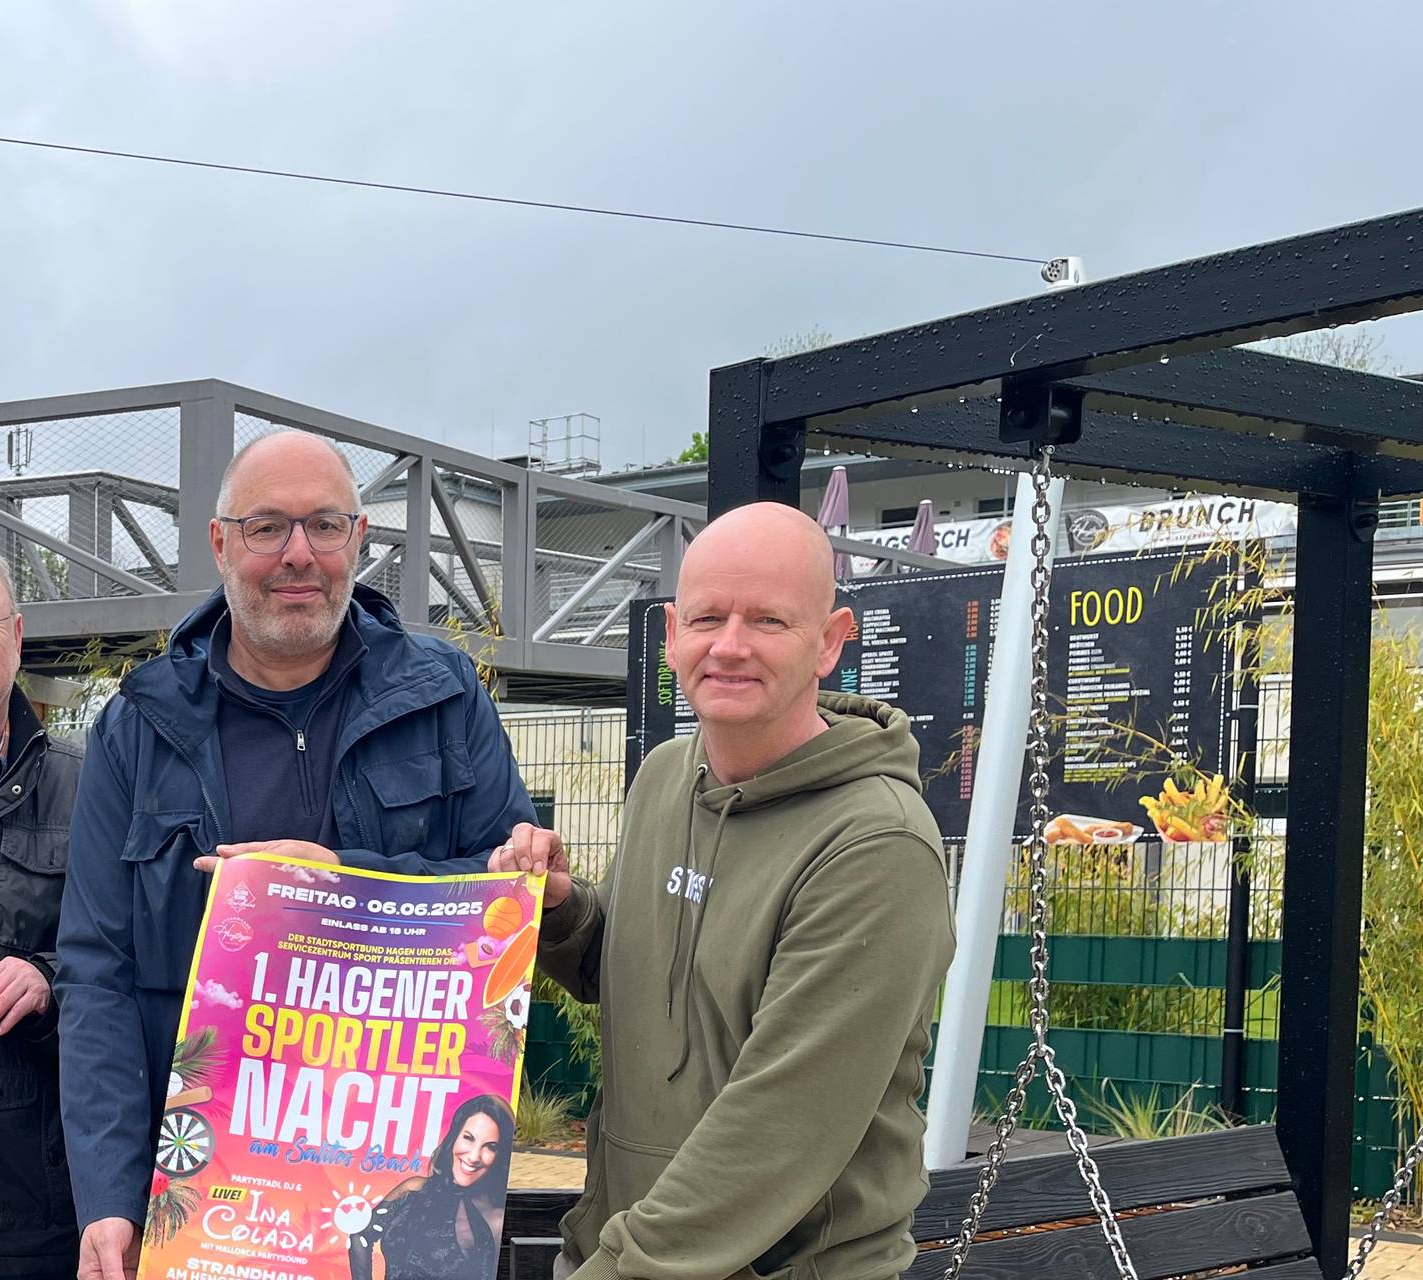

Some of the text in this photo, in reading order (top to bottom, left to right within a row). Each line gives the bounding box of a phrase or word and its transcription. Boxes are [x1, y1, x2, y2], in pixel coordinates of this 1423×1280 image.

[1070, 586, 1144, 627] FOOD
[267, 883, 357, 910] FREITAG
[367, 899, 483, 916] 06.06.2025
[321, 917, 427, 936] EINLASS AB 18 UHR
[277, 940, 352, 960] SERVICEZENTRUM
[353, 953, 381, 963] SPORT
[383, 954, 442, 966] PRÄSENTIEREN
[288, 933, 453, 957] DER STADTSPORTBUND HAGEN UND DAS
[250, 951, 473, 1020] 1. HAGENER
[242, 1003, 467, 1076] SPORTLER
[229, 1056, 459, 1158] NACHT
[248, 1136, 423, 1173] am Salitos Beach
[230, 1174, 281, 1189] PARTYSTADL
[283, 1182, 295, 1191] DJ
[211, 1188, 290, 1227] LIVE! INA
[202, 1204, 314, 1253] COLADA
[200, 1242, 308, 1265] MIT MALLORCA PARTYSOUND
[166, 1267, 187, 1280] AM
